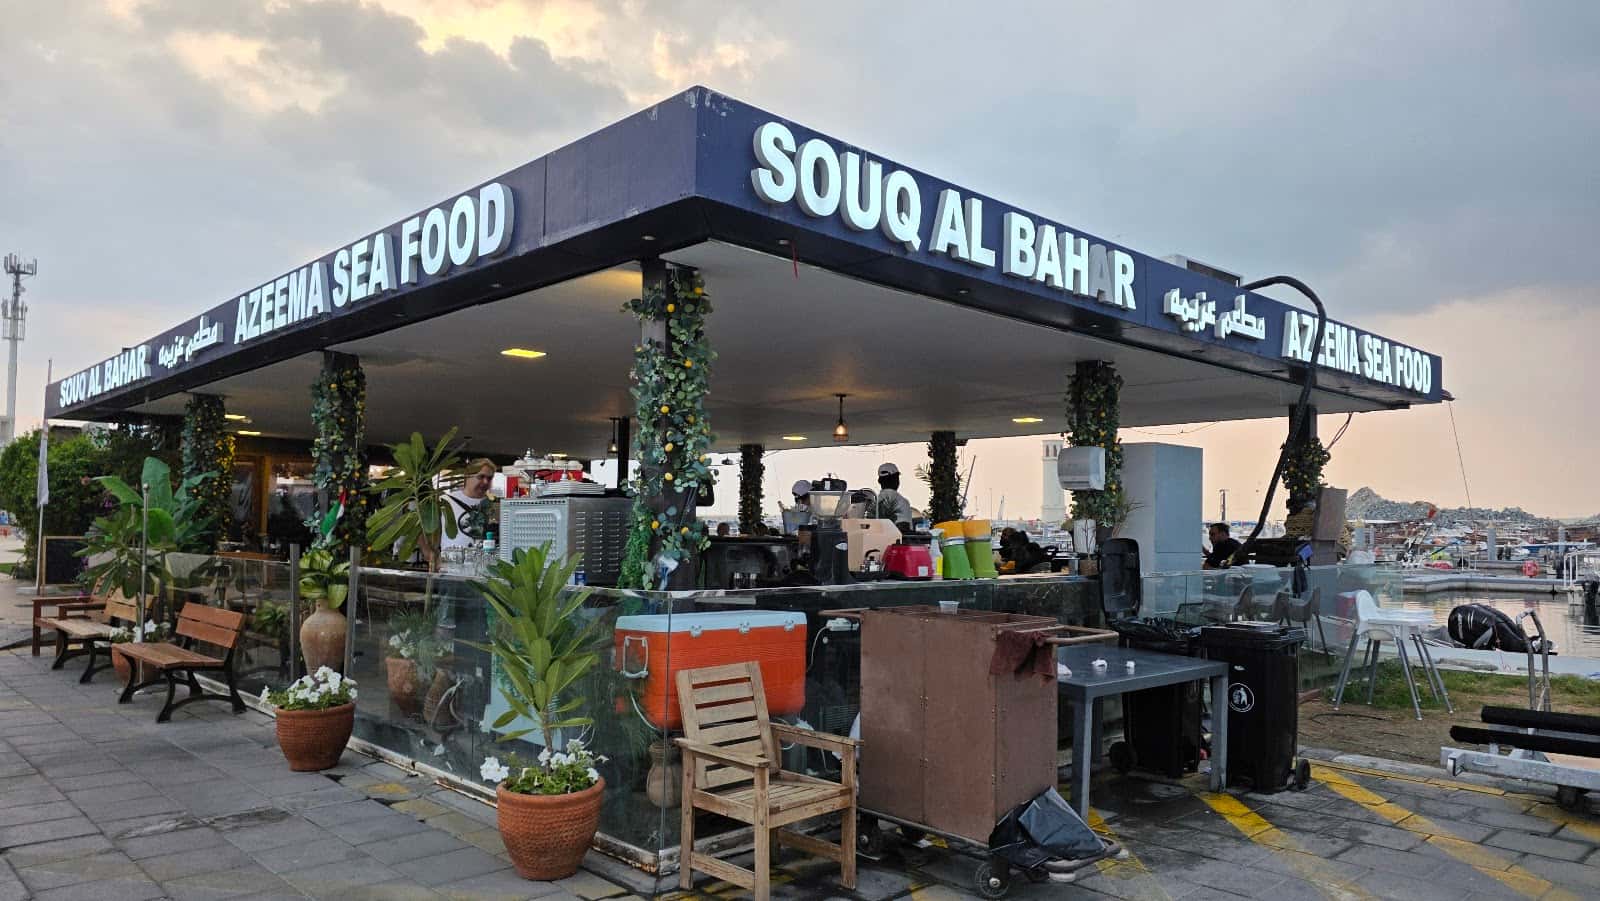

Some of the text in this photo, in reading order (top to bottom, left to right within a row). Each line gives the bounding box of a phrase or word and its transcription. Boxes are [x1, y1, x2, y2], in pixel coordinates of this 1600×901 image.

[752, 121, 1137, 311] SOUQ AL BAHAR
[234, 182, 511, 345] AZEEMA SEA FOOD
[185, 315, 221, 362] مطعم
[1215, 294, 1266, 340] مطعم
[87, 365, 102, 398] AL
[103, 344, 148, 392] BAHAR
[1360, 334, 1393, 384] SEA
[1393, 345, 1432, 394] FOOD
